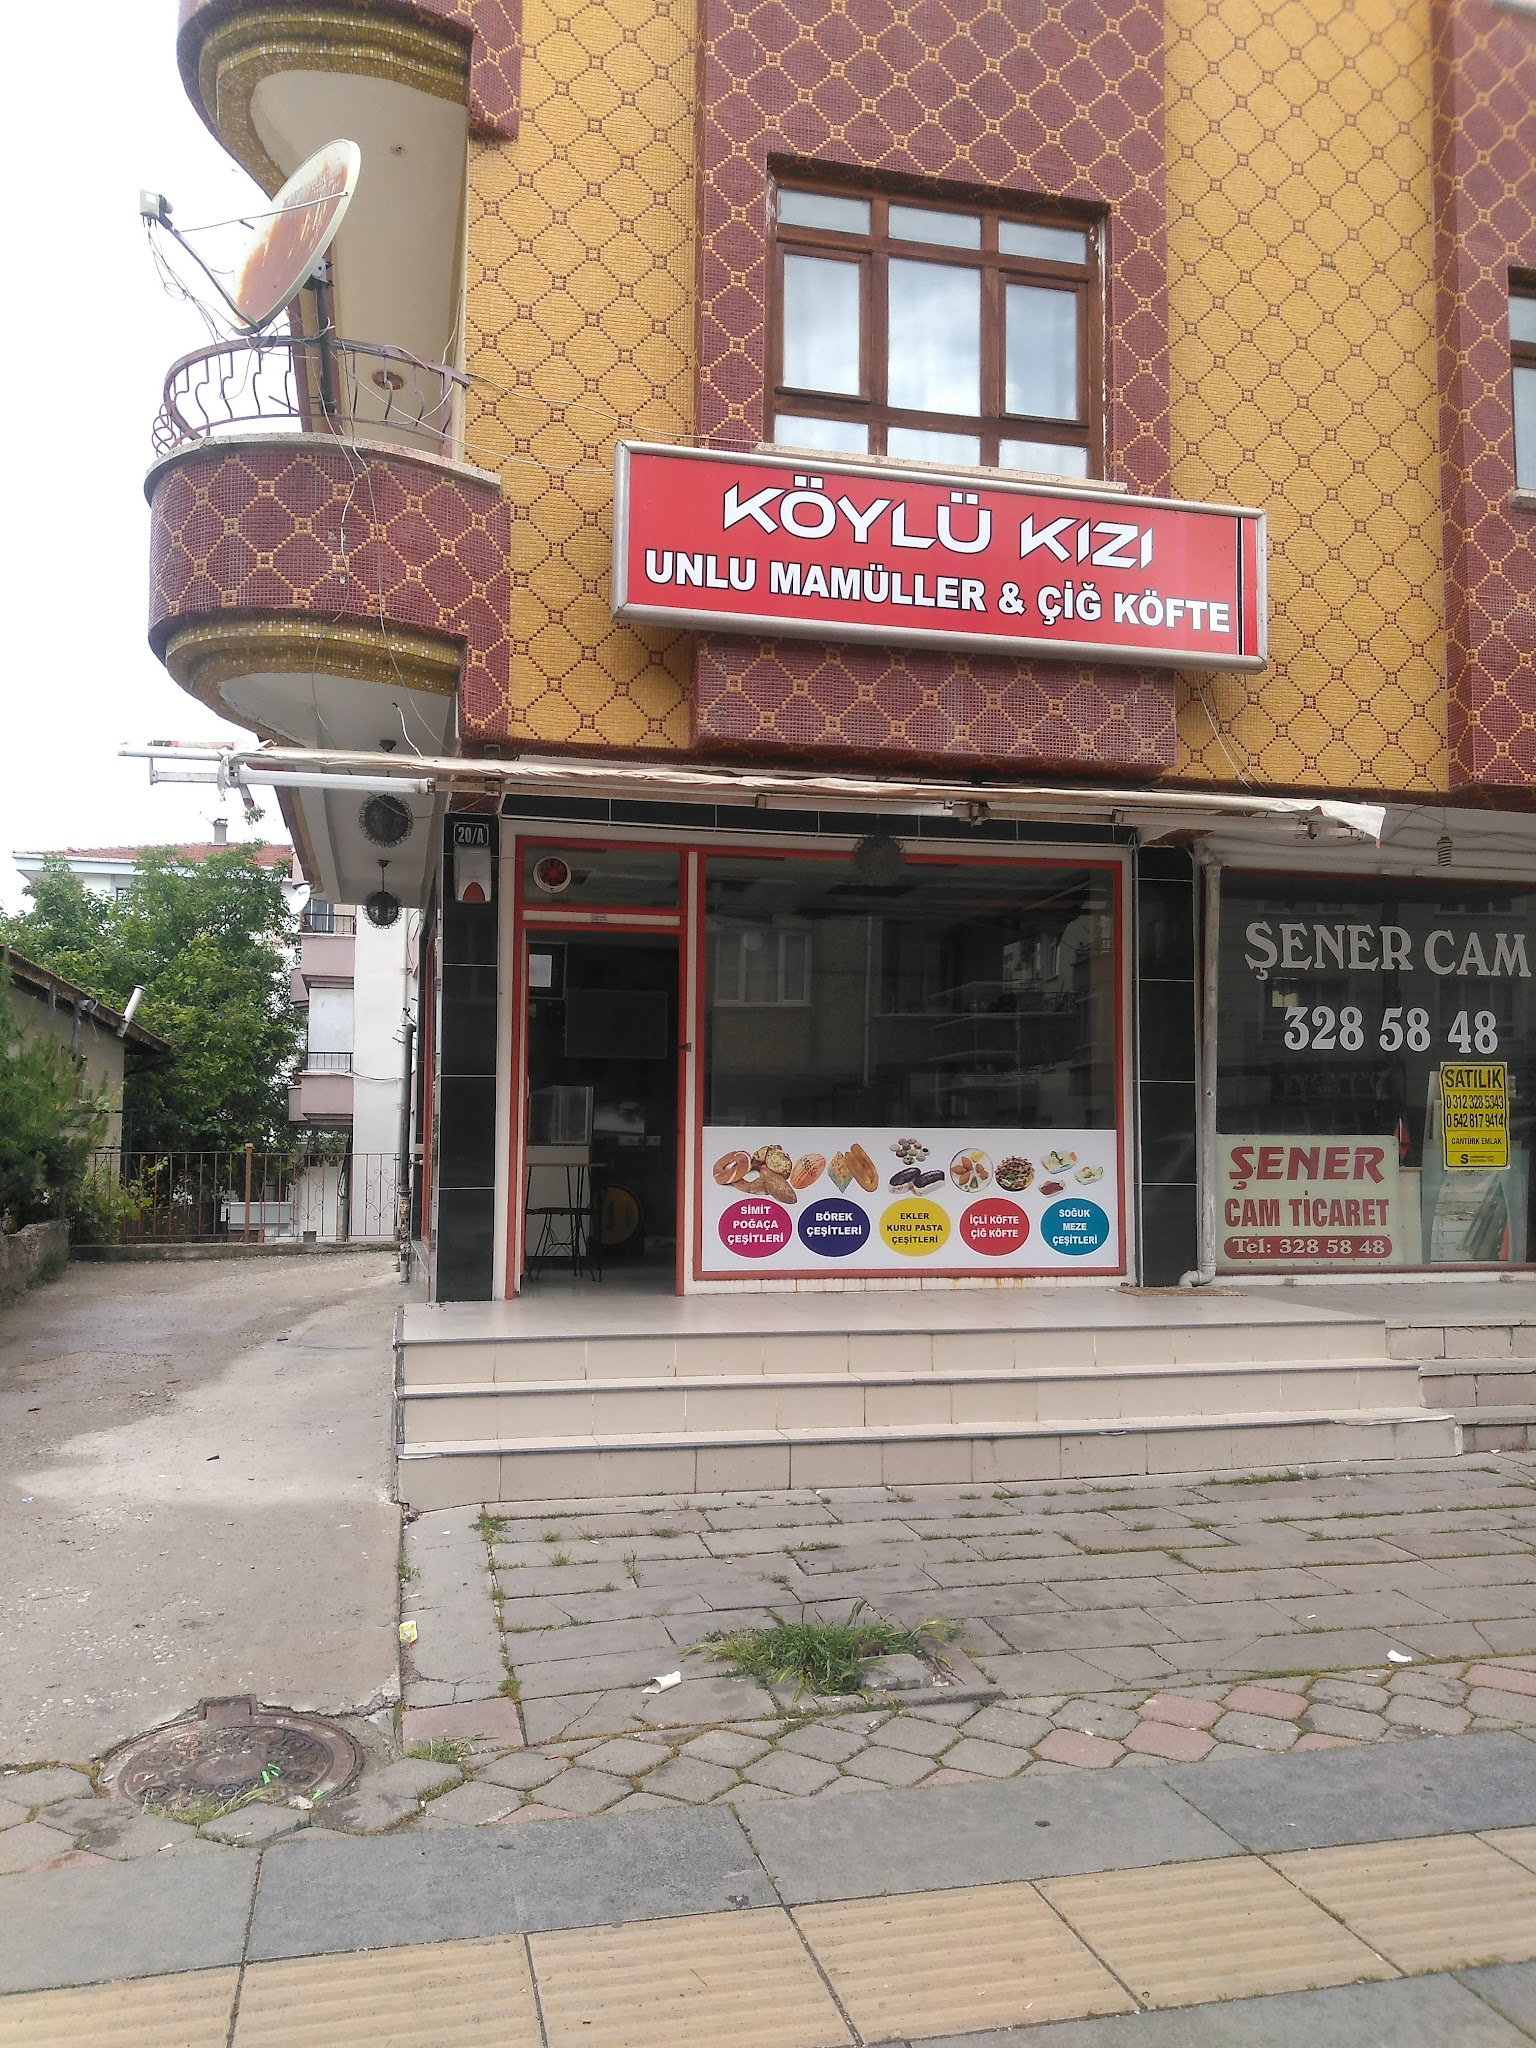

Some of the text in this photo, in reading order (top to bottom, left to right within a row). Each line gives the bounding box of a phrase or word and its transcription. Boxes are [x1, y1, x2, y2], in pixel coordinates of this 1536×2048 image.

[723, 473, 1155, 570] KÖYLÜ KIZI
[645, 549, 1231, 634] UNLU MAMÜLLER & ÇİĞ KÖFTE
[458, 826, 484, 844] 20/A
[1244, 921, 1532, 981] ŞENER CAM
[1284, 1005, 1498, 1055] 328 58 48
[1445, 1068, 1503, 1089] SATILIK
[1446, 1094, 1452, 1110] 0
[1453, 1094, 1468, 1110] 312
[1446, 1113, 1452, 1128] 0
[1453, 1113, 1468, 1128] 542
[1470, 1113, 1484, 1128] 817
[1481, 1137, 1502, 1145] EMLAK
[1229, 1145, 1386, 1190] ŞENER
[740, 1203, 771, 1215] SİMİT
[815, 1210, 853, 1222] BÖREK
[899, 1212, 930, 1221] EKLER
[1059, 1207, 1091, 1219] SOĞUK
[1224, 1190, 1389, 1228] CAM TİCARET
[732, 1216, 779, 1232] POĞAÇA
[969, 1213, 1020, 1227] İÇLİ KÖFTE
[1063, 1222, 1087, 1232] MEZE
[806, 1223, 862, 1238] ÇEŞİTLERİ
[886, 1223, 944, 1233] KURU PASTA
[970, 1226, 1019, 1240] ÇİĞ KÖFTE
[727, 1231, 784, 1245] ÇEŞİTLERİ
[891, 1233, 938, 1246] ÇEŞİTLERİ
[1052, 1234, 1098, 1247] ÇEŞİTLERİ
[1233, 1237, 1385, 1255] Tel: 328 58 48
